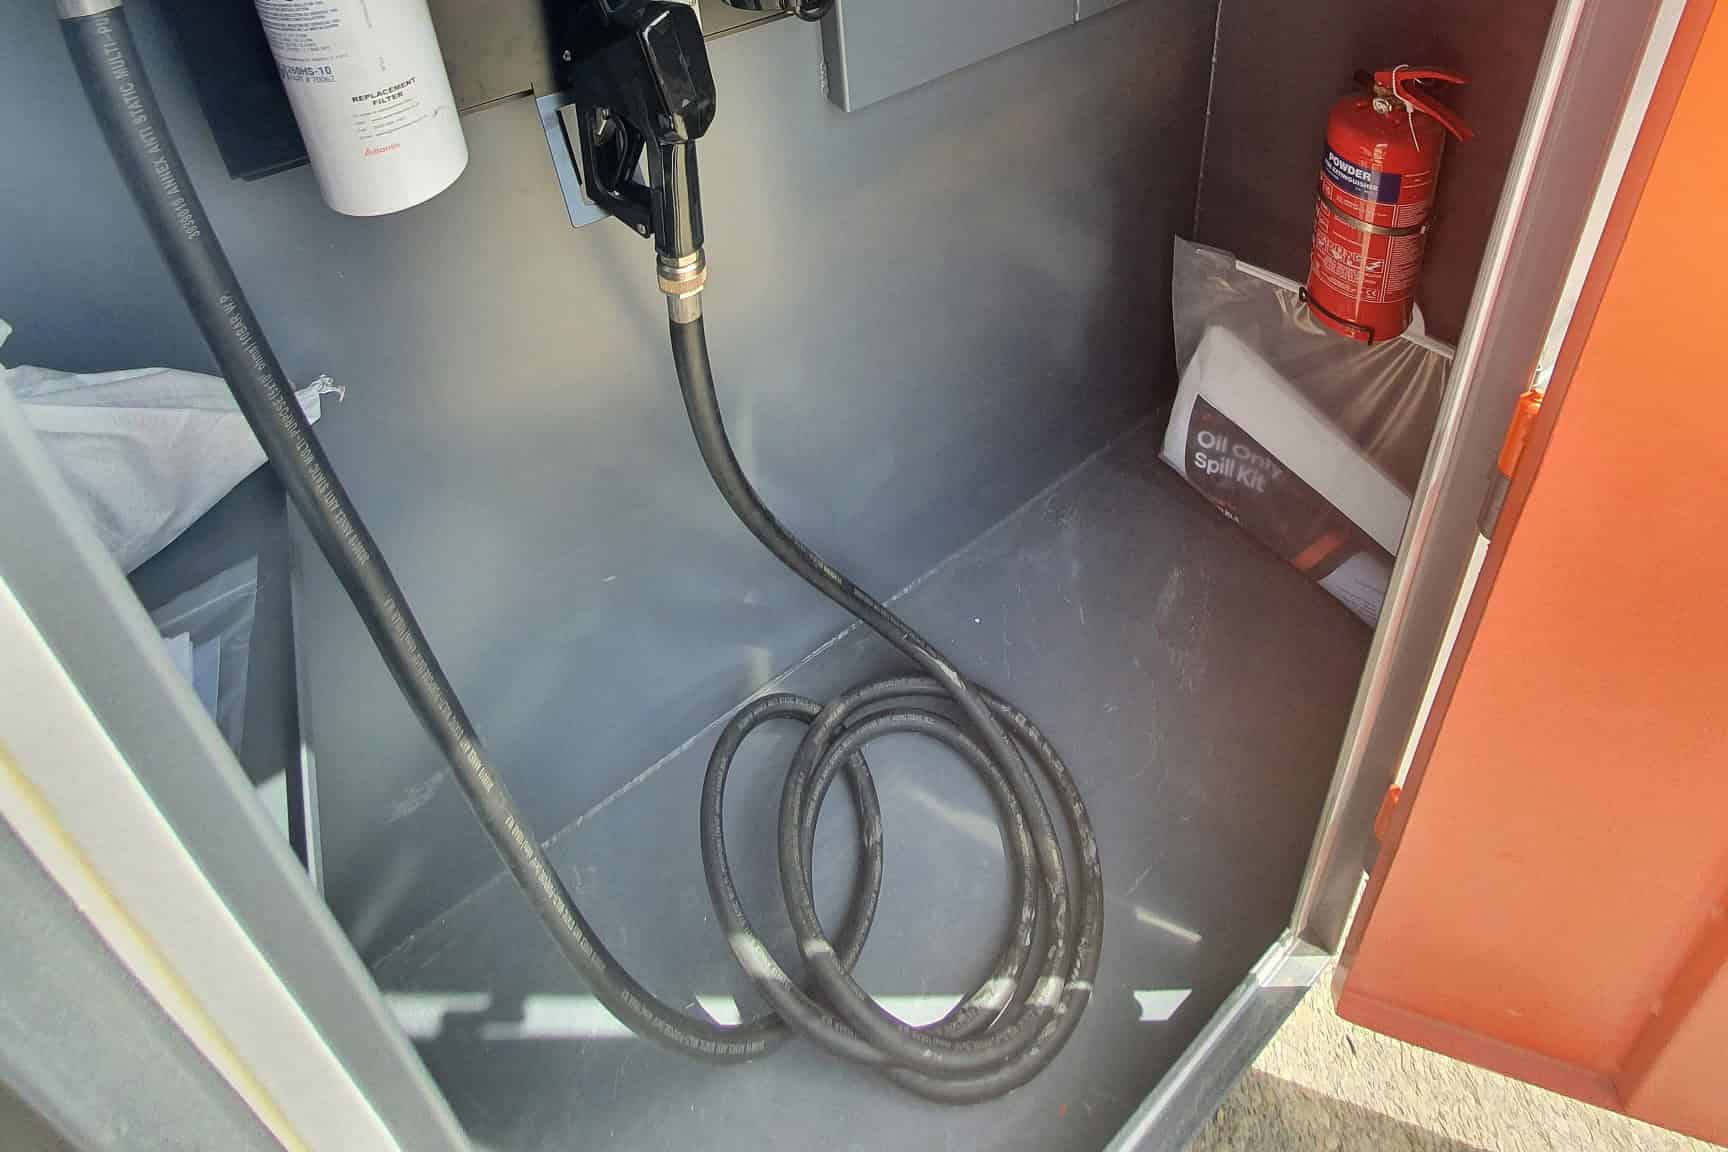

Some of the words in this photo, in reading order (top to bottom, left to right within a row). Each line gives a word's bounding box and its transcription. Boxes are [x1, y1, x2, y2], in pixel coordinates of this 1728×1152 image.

[352, 75, 417, 104] REPLACEMENT
[372, 91, 404, 106] FILTER
[1328, 151, 1373, 182] POWDER
[1196, 429, 1229, 455] Oil
[1194, 451, 1236, 477] Spill
[1236, 467, 1266, 494] Kit
